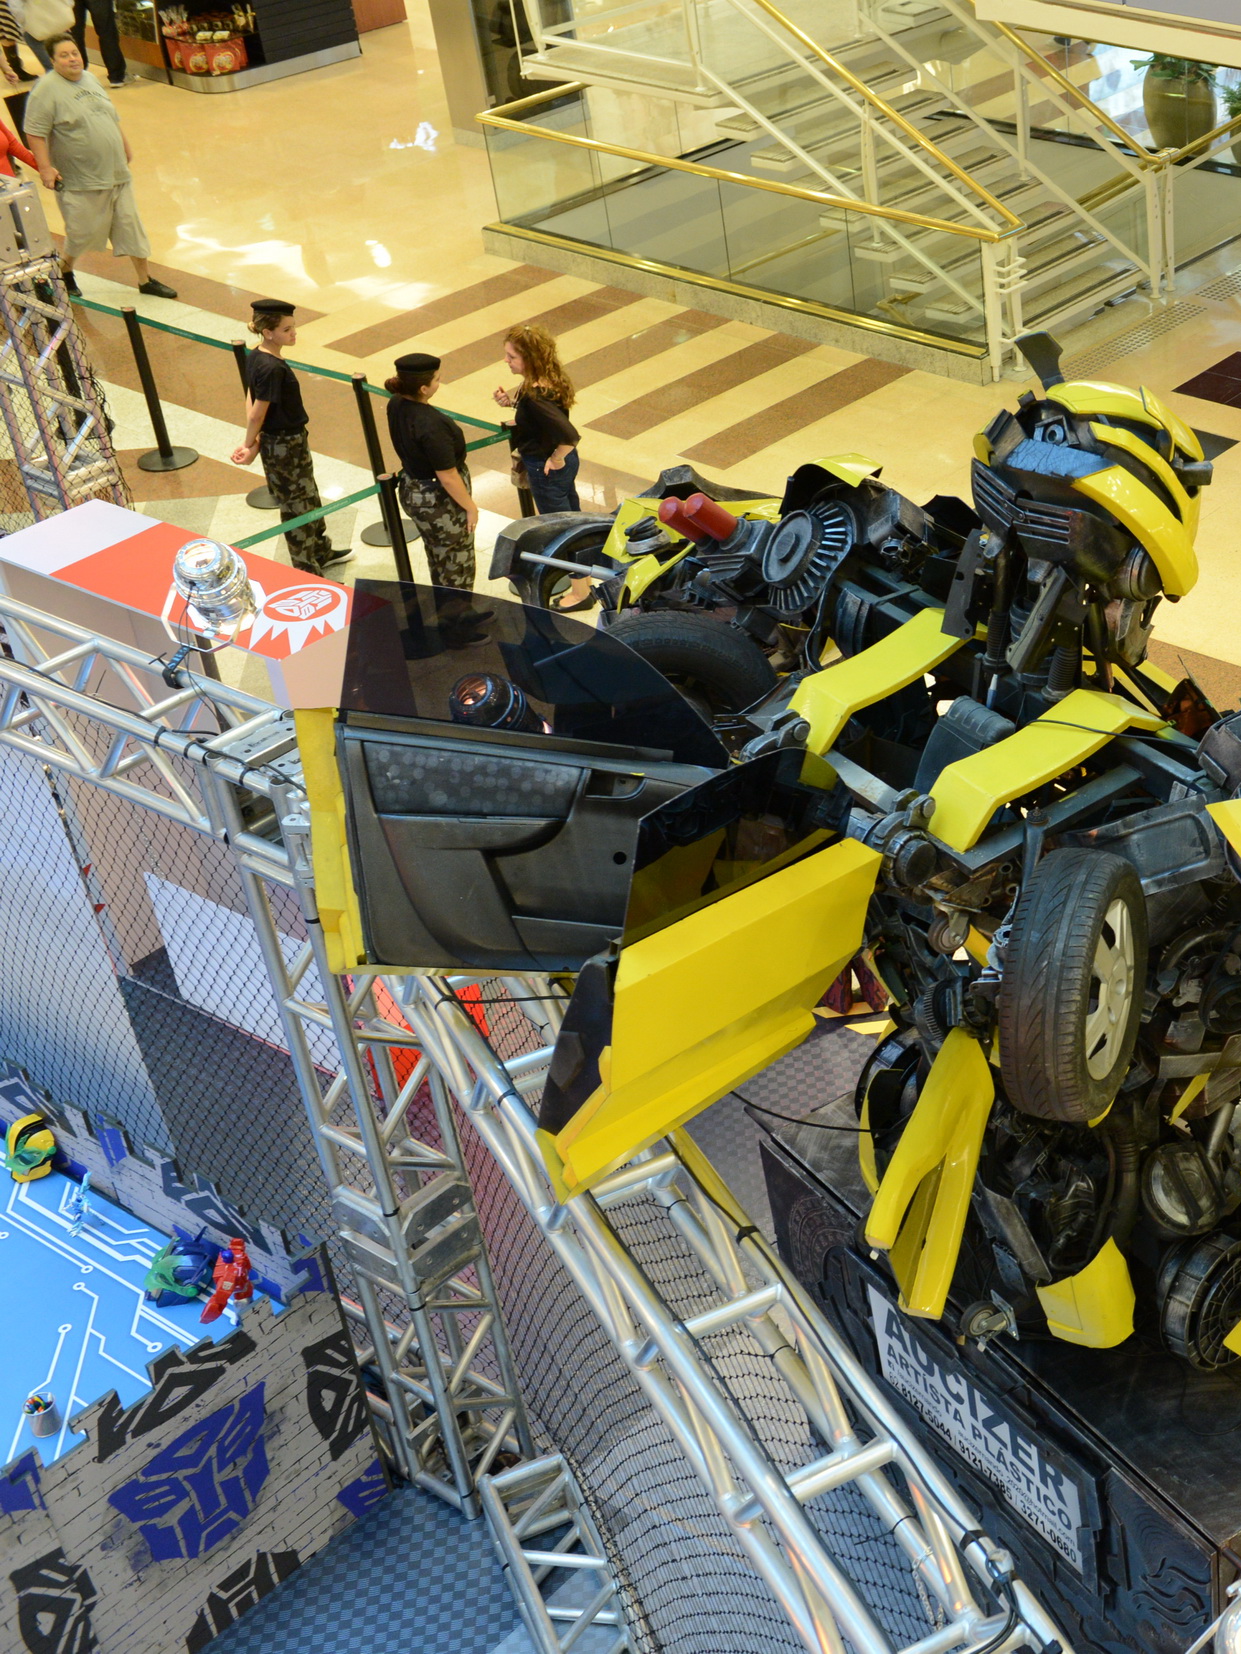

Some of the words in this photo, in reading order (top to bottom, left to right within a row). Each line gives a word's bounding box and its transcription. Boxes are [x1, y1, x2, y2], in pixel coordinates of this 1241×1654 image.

[901, 1384, 953, 1441] 8127-5044
[1020, 1500, 1077, 1563] 3271-0680
[971, 1423, 1072, 1531] PLÁSTICO
